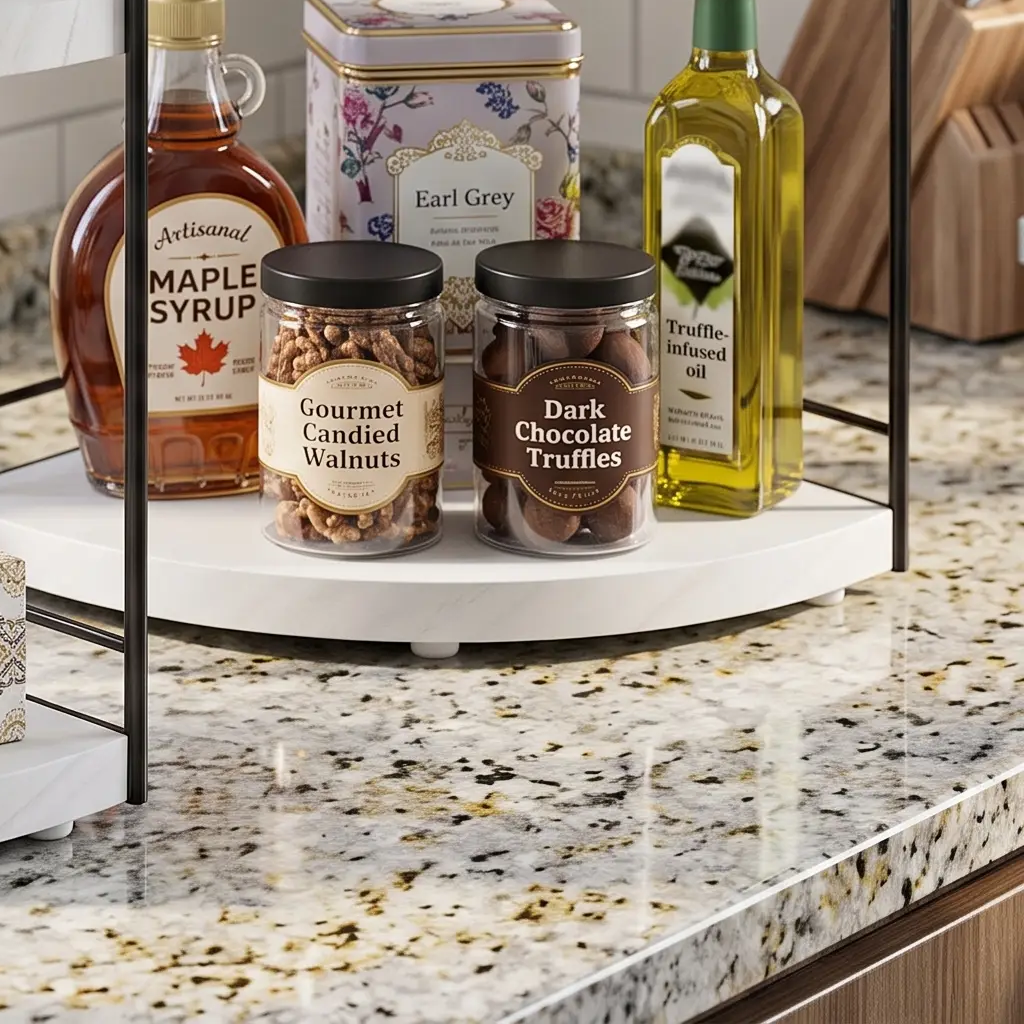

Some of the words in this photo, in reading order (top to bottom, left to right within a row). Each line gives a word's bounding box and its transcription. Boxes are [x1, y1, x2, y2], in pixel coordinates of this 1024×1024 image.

[415, 188, 458, 209] Earl
[464, 188, 515, 211] Grey
[154, 221, 253, 251] Artisanal
[149, 263, 258, 295] MAPLE
[150, 294, 257, 324] SYRUP
[666, 318, 730, 341] Truffle-
[666, 339, 727, 362] infused
[686, 363, 707, 380] oil
[300, 397, 404, 420] Gourmet
[543, 398, 607, 420] Dark
[303, 422, 400, 445] Candied
[515, 420, 632, 445] Chocolate
[302, 446, 401, 470] Walnuts
[526, 446, 623, 469] Truffles
